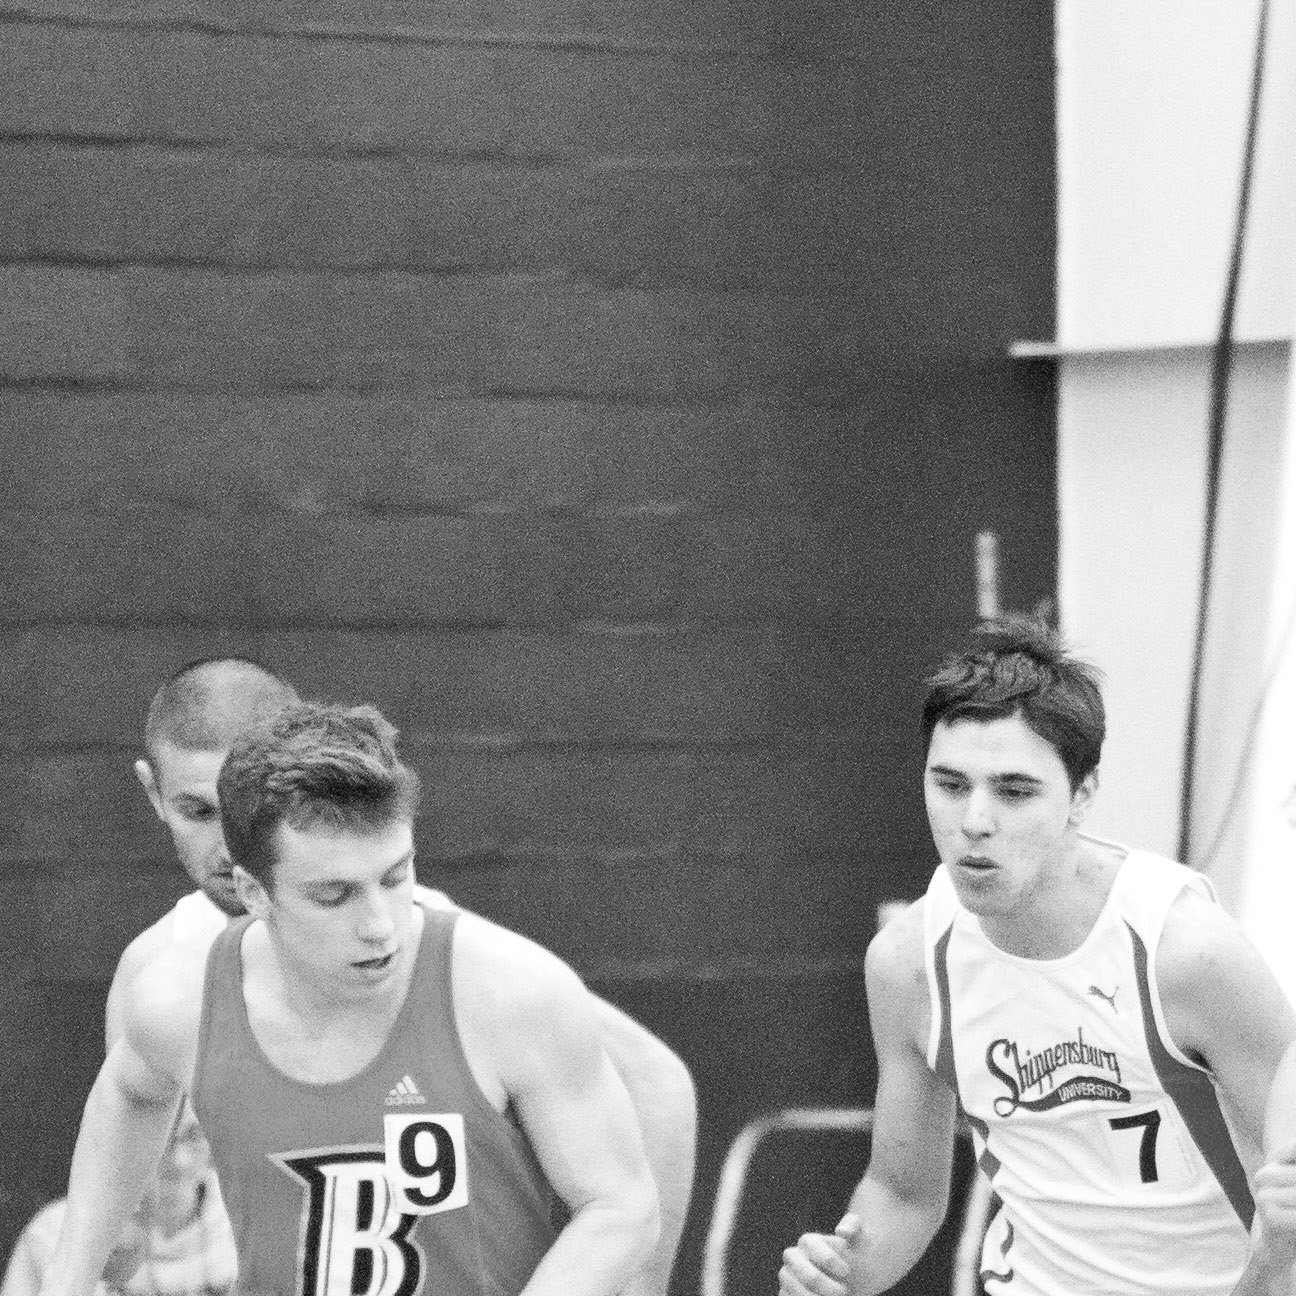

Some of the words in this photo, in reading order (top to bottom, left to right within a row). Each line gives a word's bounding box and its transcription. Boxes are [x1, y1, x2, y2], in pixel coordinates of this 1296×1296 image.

[986, 1026, 1121, 1117] Shippensburg
[1058, 1082, 1123, 1101] UNIVERSITY
[399, 1121, 457, 1206] 9
[1108, 1109, 1162, 1184] 7
